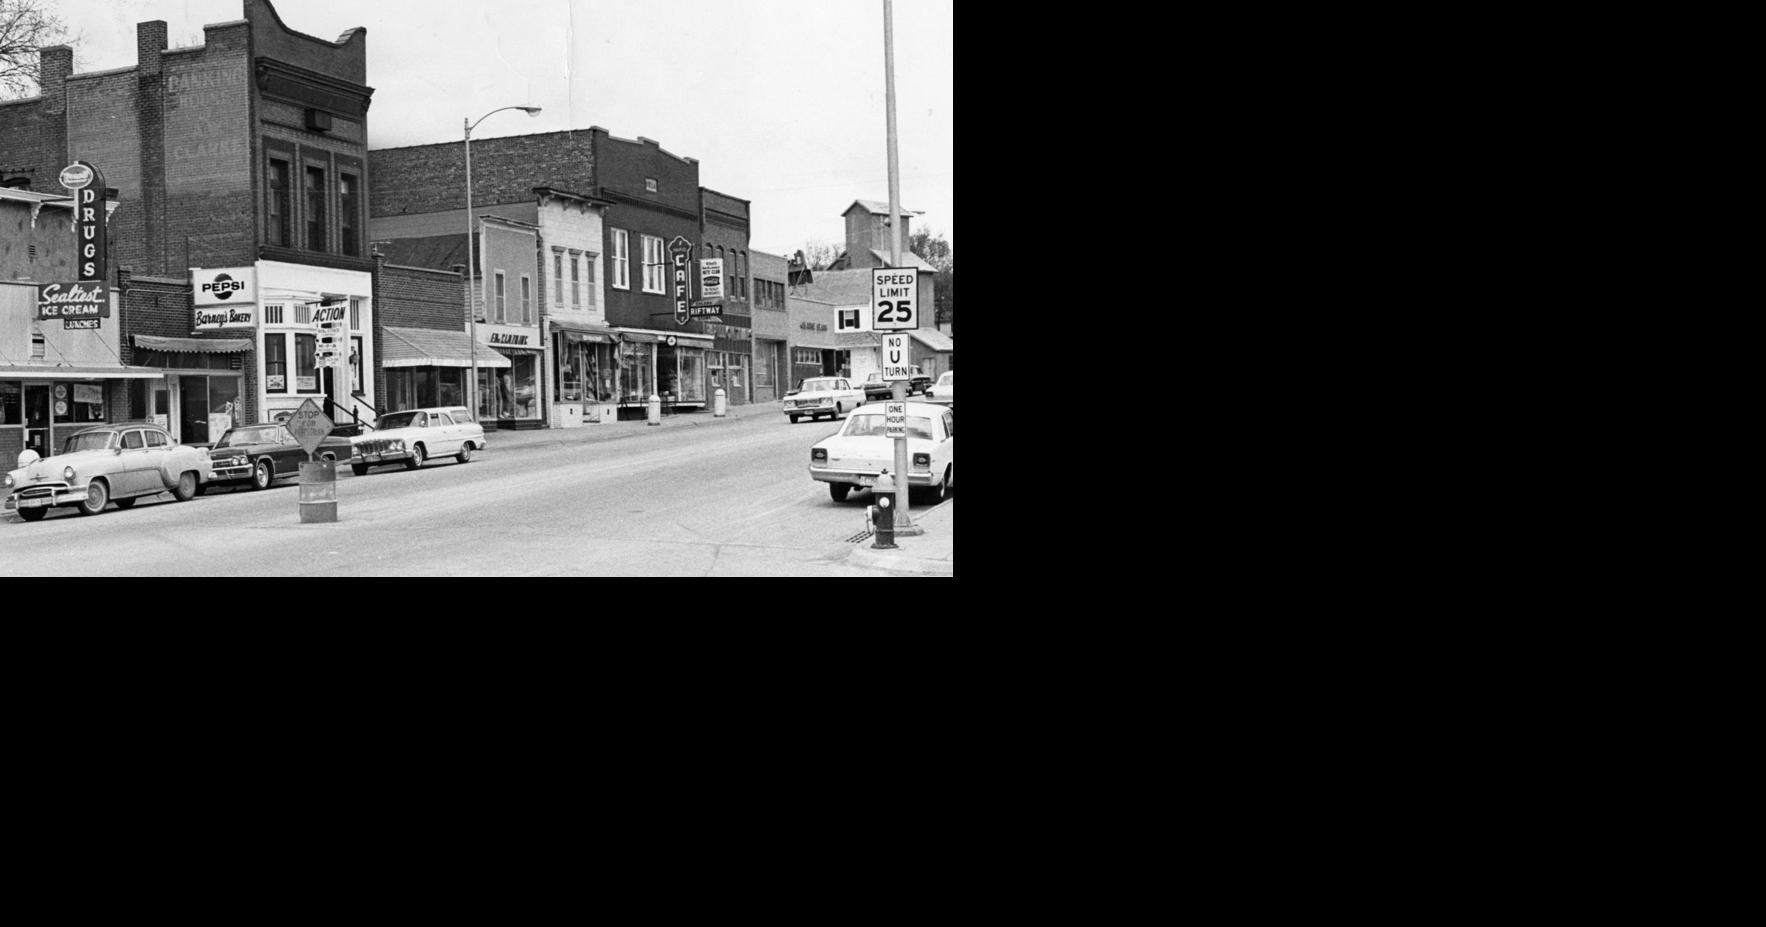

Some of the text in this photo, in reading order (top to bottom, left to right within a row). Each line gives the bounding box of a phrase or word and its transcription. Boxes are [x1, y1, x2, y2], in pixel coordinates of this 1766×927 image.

[83, 190, 96, 277] DRUGS
[676, 254, 686, 313] CAFE
[877, 275, 914, 285] SPEED
[202, 281, 245, 293] PEPSI
[39, 284, 103, 304] Sealtest
[880, 288, 910, 298] LIMIT
[42, 305, 98, 315] ICE CREAM
[312, 307, 346, 322] ACTION
[690, 306, 720, 315] RIFTWAY
[877, 300, 912, 322] 25
[889, 338, 901, 347] NO
[890, 350, 901, 364] U
[885, 367, 908, 376] TURN
[298, 411, 319, 419] STOP
